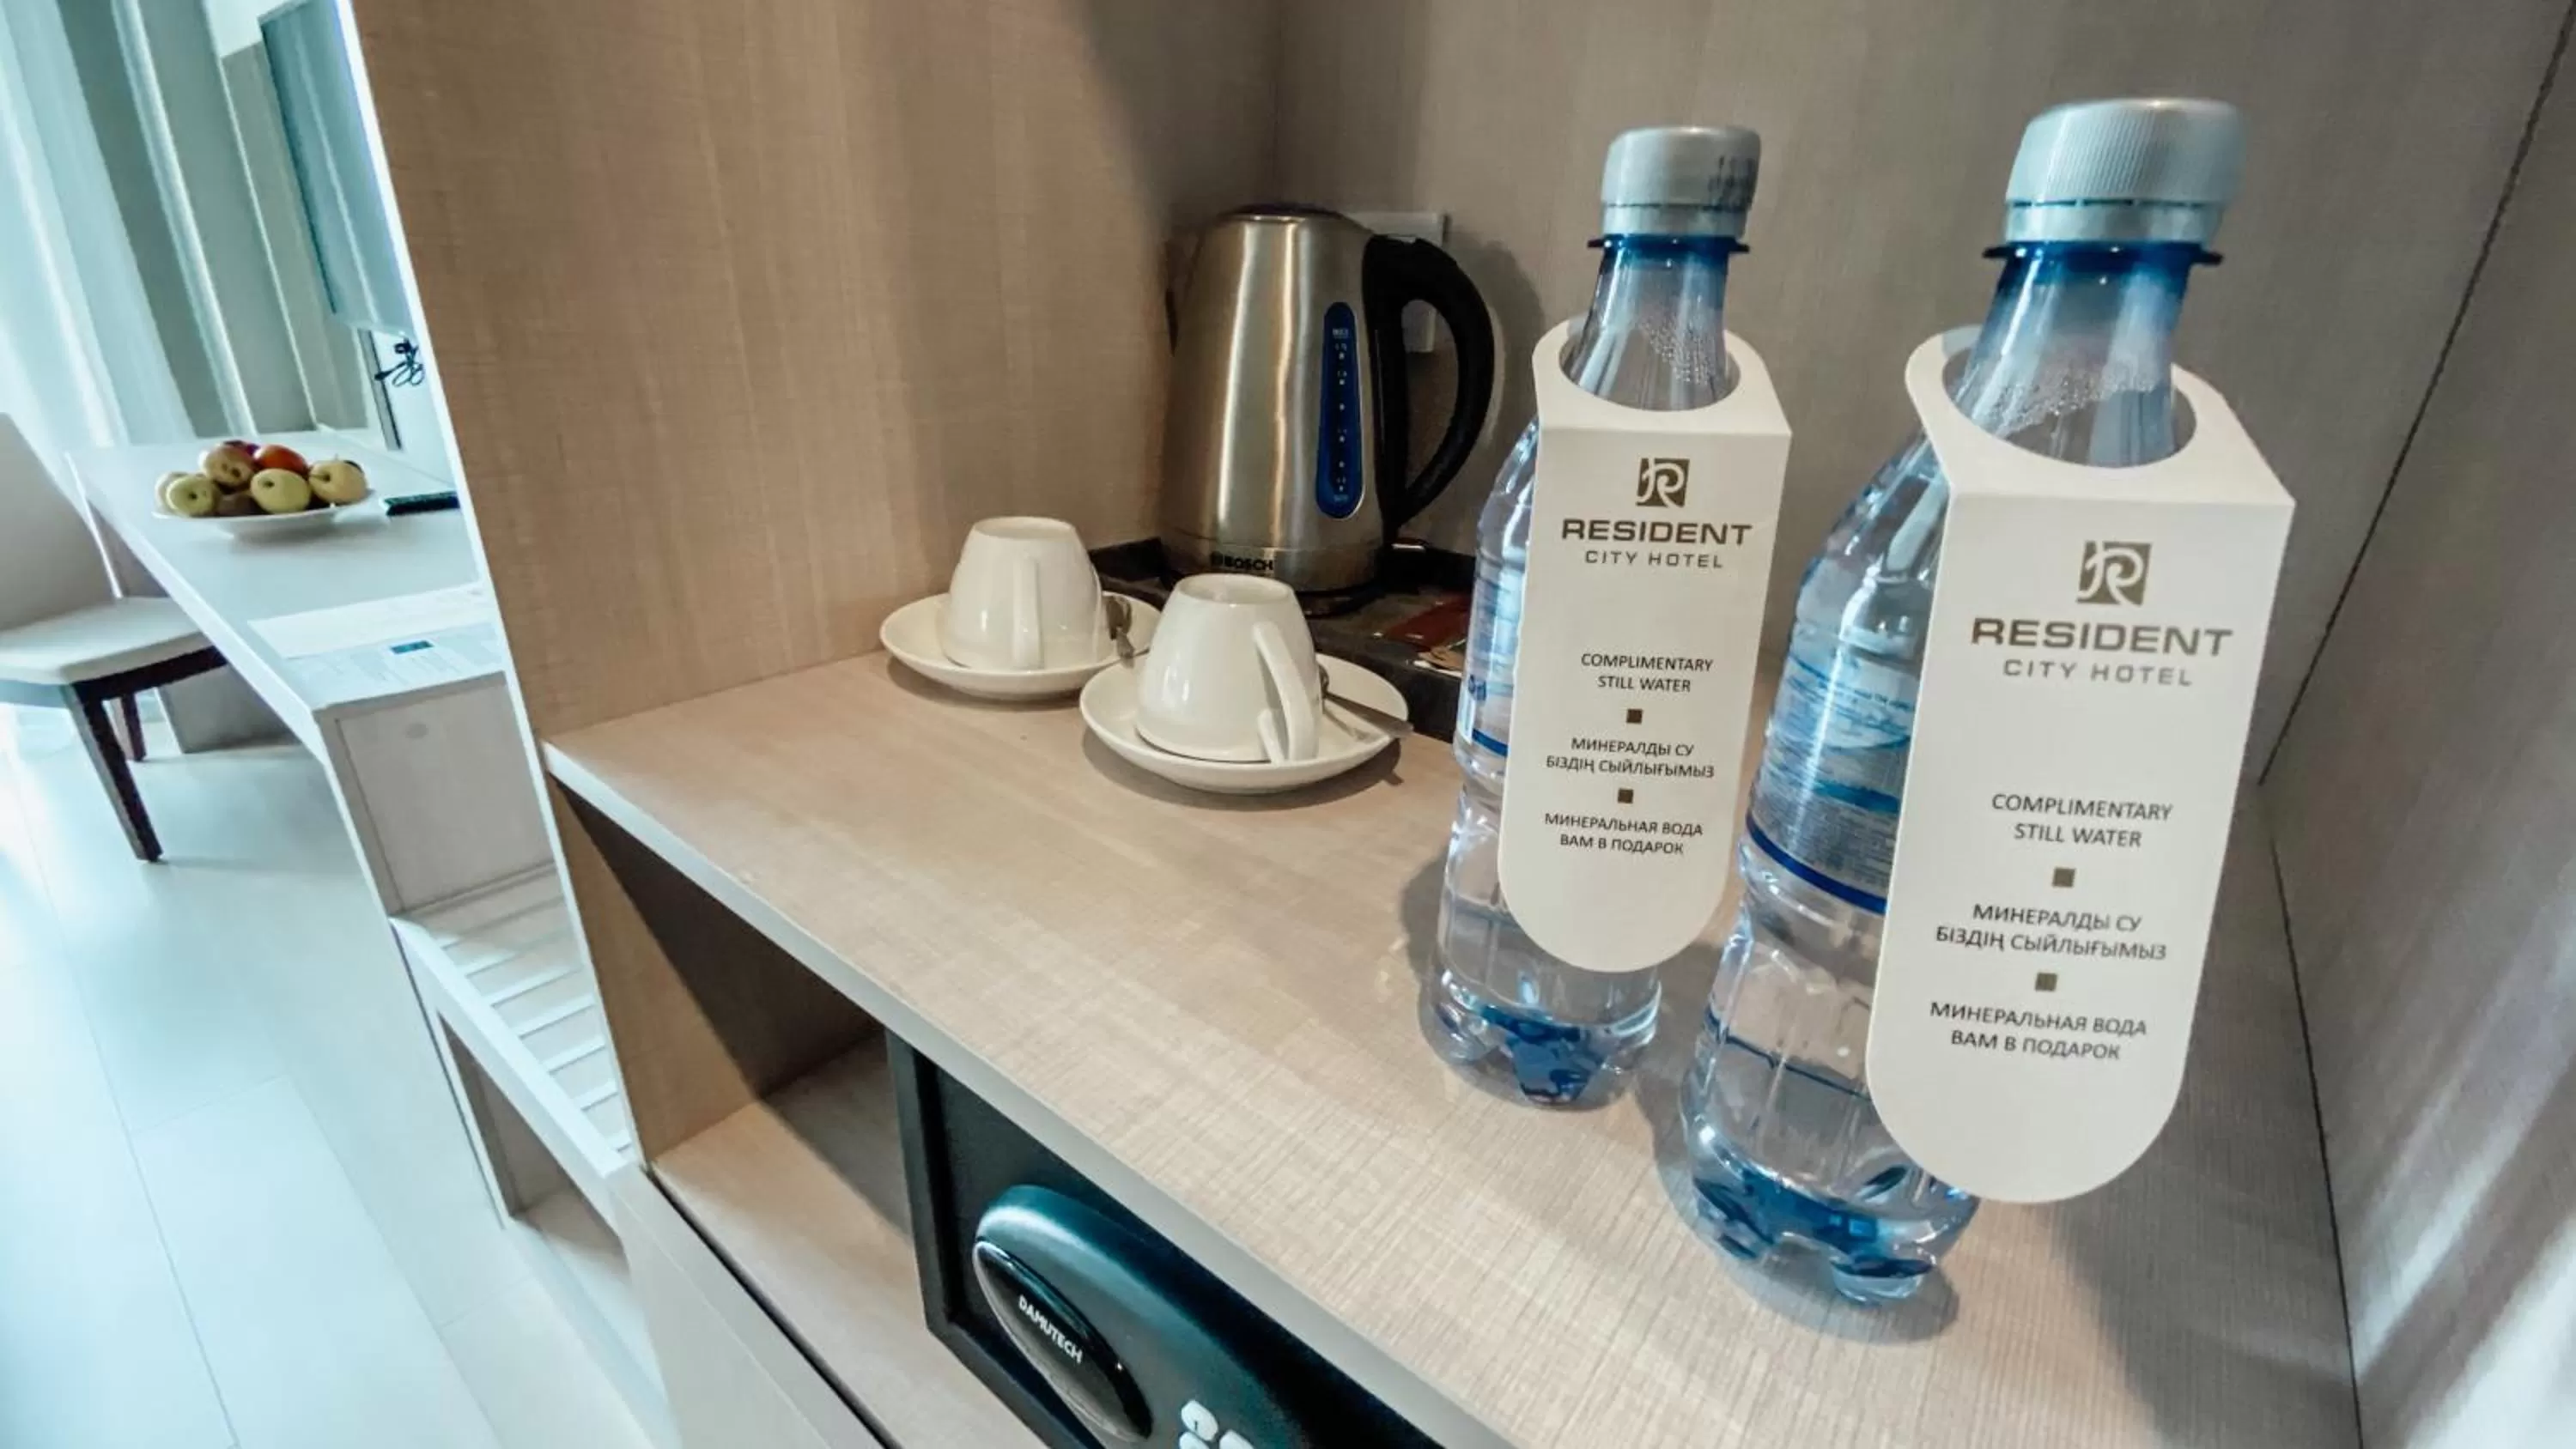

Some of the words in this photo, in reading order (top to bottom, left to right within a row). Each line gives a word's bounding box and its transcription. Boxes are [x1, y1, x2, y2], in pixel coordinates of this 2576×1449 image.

[1561, 518, 1753, 547] RESIDENT
[1584, 549, 1637, 566] CITY
[1648, 552, 1723, 569] HOTEL
[1971, 616, 2233, 657] RESIDENT
[1580, 652, 1714, 672] COMPLIMENTARY
[2003, 658, 2076, 679] CITY
[2090, 664, 2192, 687] HOTEL
[1597, 675, 1635, 690] STILL
[1639, 676, 1692, 693] WATER
[1571, 737, 1672, 758] МИНЕРАЛДЫ
[1674, 743, 1695, 757] СУ
[1991, 792, 2173, 822] COMPLIMENTARY
[1544, 812, 1659, 834] МИНЕРАЛЬНАЯ
[1662, 821, 1704, 839] ВОДА
[2014, 822, 2066, 844] STILL
[2071, 827, 2142, 848] WATER
[1559, 833, 1595, 849] ВАМ
[1597, 837, 1607, 850] В
[1610, 838, 1684, 856] ПОДАРОК
[1972, 903, 2111, 932] МИНЕРАЛДЫ
[2115, 914, 2142, 932] СУ
[1929, 1001, 2088, 1032] МИНЕРАЛЬНАЯ
[2092, 1016, 2147, 1038] ВОДА
[1950, 1029, 1999, 1050] ВАМ
[2003, 1035, 2017, 1052] В
[2022, 1037, 2121, 1060] ПОДАРОК
[1018, 1294, 1083, 1364] DAMUTECH
